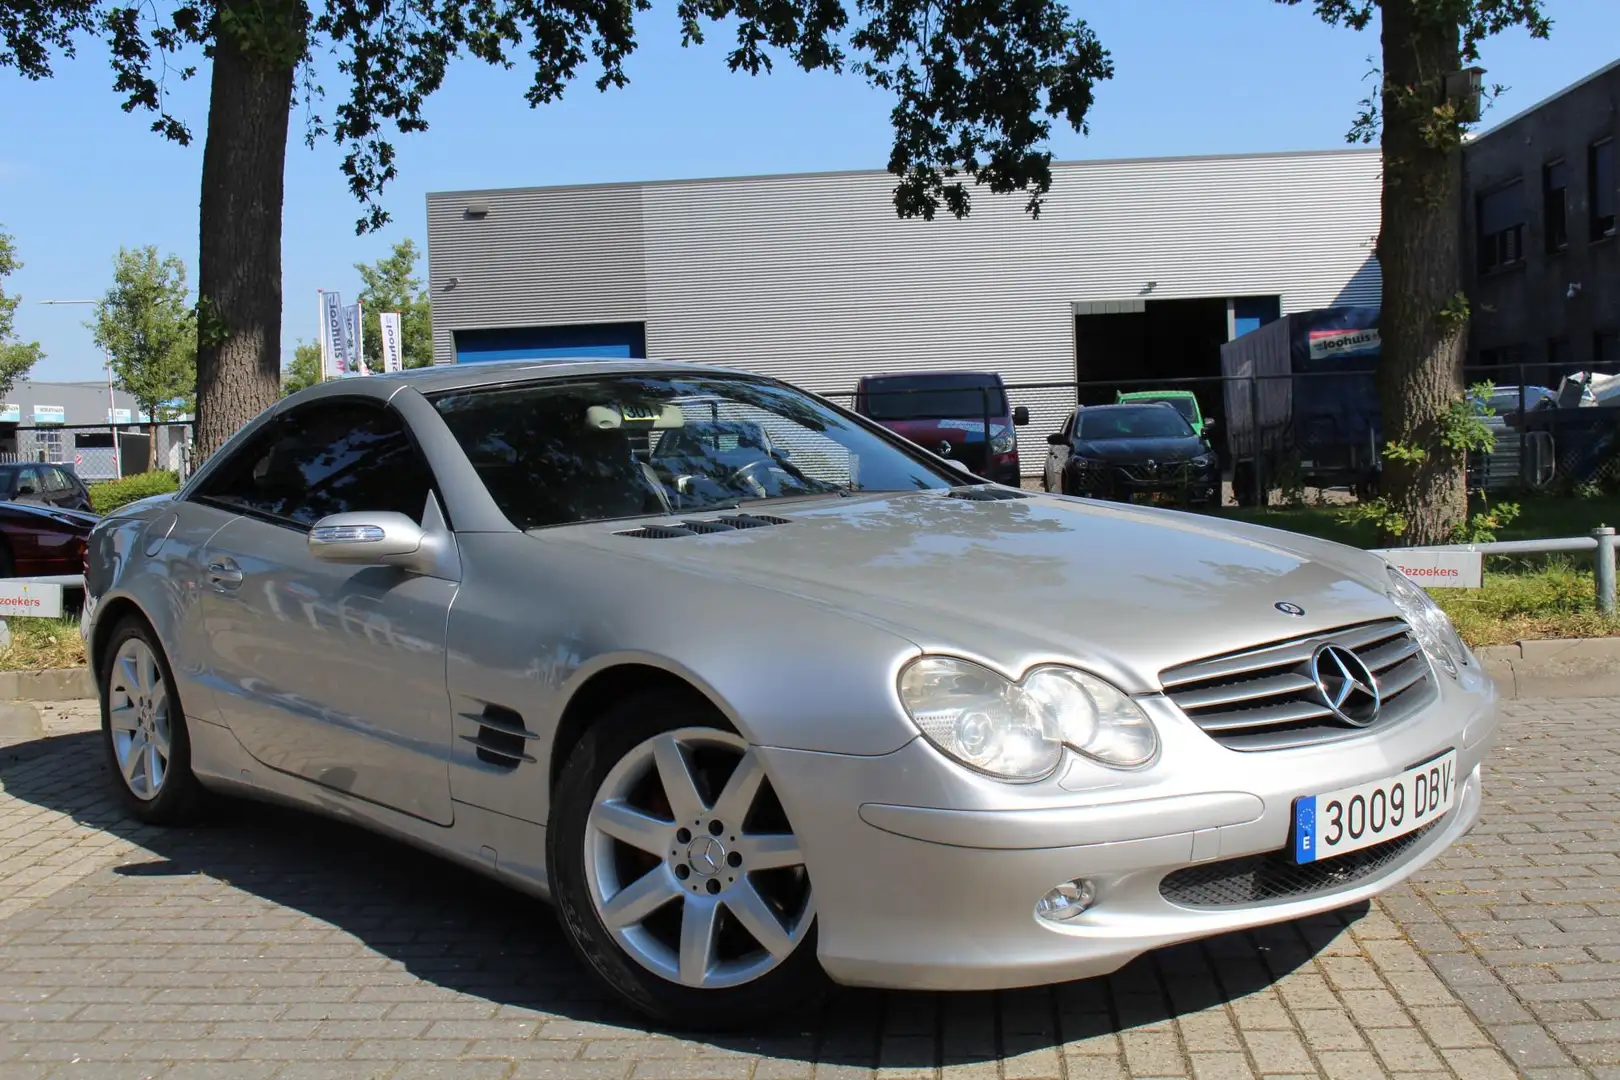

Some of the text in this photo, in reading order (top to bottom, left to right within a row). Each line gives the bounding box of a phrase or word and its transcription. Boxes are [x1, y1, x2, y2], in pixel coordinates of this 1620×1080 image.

[1323, 333, 1370, 349] loohuis
[1325, 760, 1451, 845] 3009 DBV
[1303, 836, 1310, 849] E
